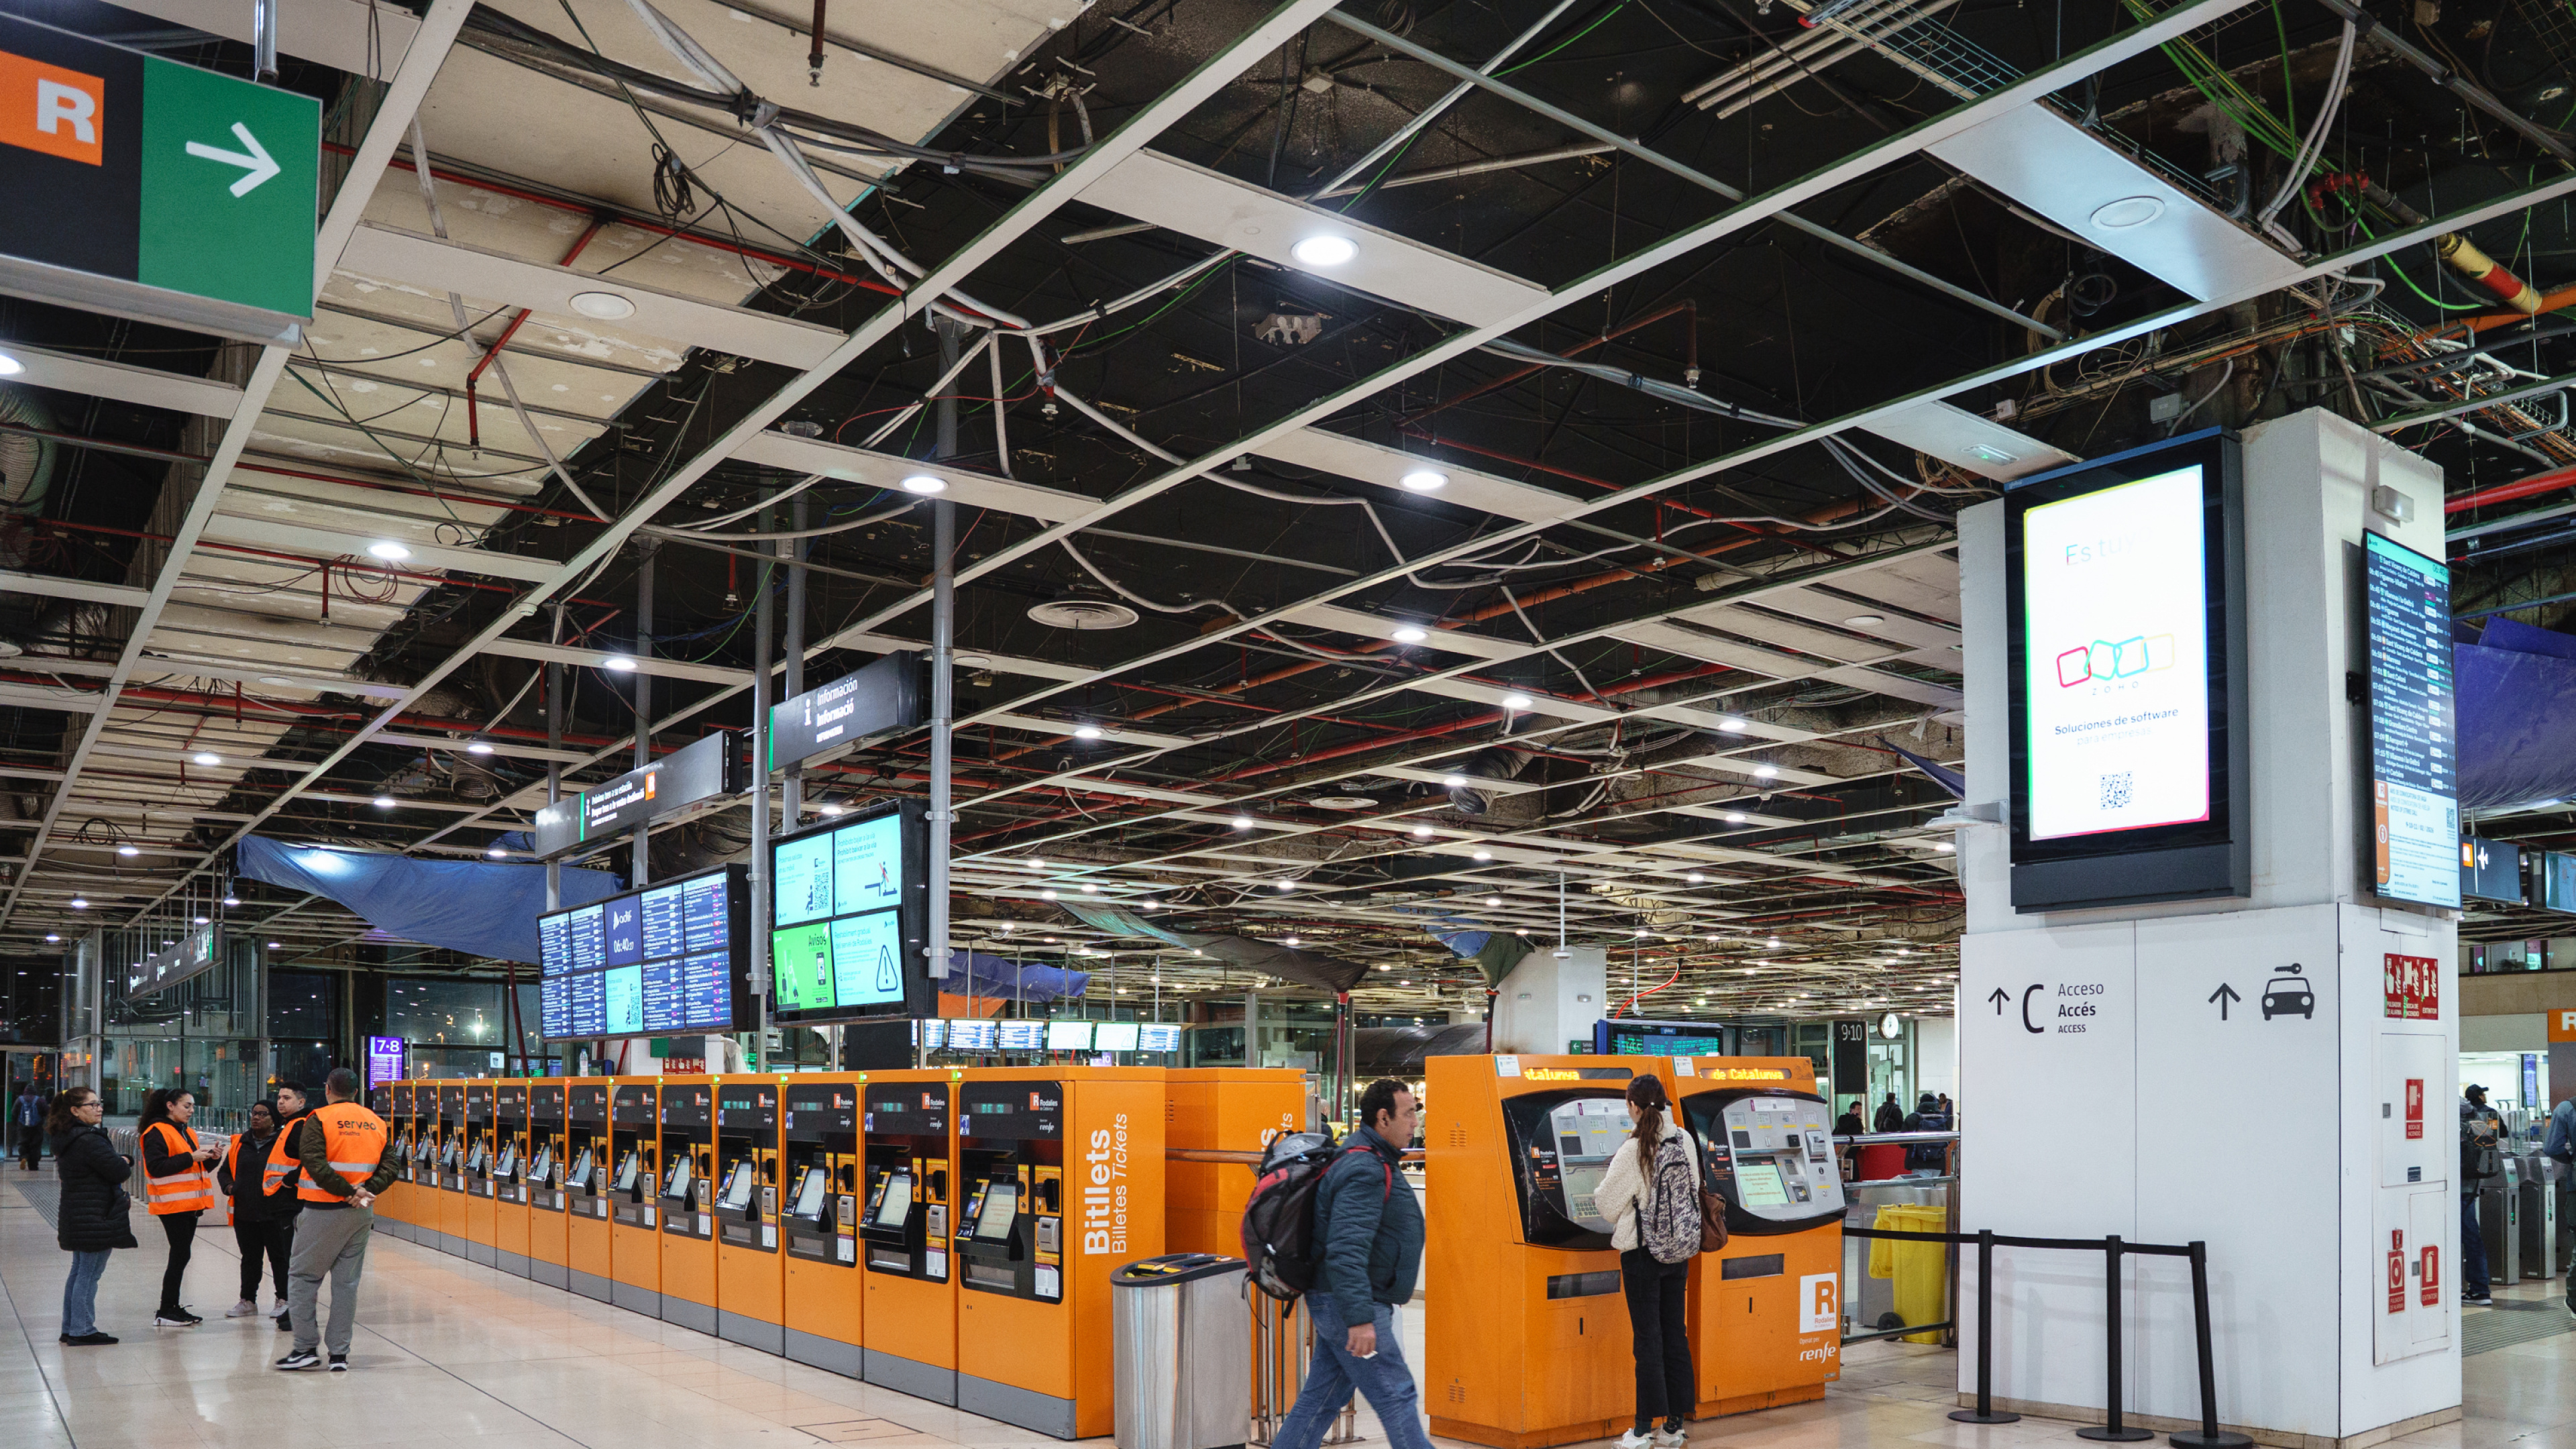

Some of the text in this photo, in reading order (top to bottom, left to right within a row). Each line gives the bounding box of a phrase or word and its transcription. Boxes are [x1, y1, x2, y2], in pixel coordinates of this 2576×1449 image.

[38, 78, 95, 144] R
[2066, 527, 2152, 566] Es tuyo
[817, 677, 857, 706] Información
[2092, 681, 2139, 695] ZOHO
[816, 698, 854, 727] Informació
[2055, 708, 2178, 735] Soluciones de software
[2077, 735, 2100, 745] para
[648, 775, 655, 793] R
[837, 847, 850, 857] Prohibit
[851, 844, 862, 853] baixar
[619, 910, 632, 923] adif
[808, 932, 826, 947] Avisos
[2057, 983, 2104, 997] Acceso
[2022, 983, 2045, 1033] C
[2057, 1002, 2096, 1018] Accés
[2562, 1012, 2576, 1031] R
[2058, 1024, 2086, 1034] ACCESS
[1713, 1068, 1784, 1080] de Catalunya
[925, 1095, 930, 1106] R
[1033, 1095, 1039, 1106] R
[1040, 1099, 1058, 1107] Rodalies
[337, 1120, 376, 1130] serveo
[1040, 1122, 1055, 1134] renfe
[1112, 1113, 1128, 1254] Billetes Tickets
[1084, 1129, 1110, 1255] Bitllets
[1815, 1280, 1835, 1316] R
[1815, 1316, 1835, 1324] Rodalies
[1799, 1338, 1813, 1346] Operat
[1800, 1341, 1836, 1364] renfe
